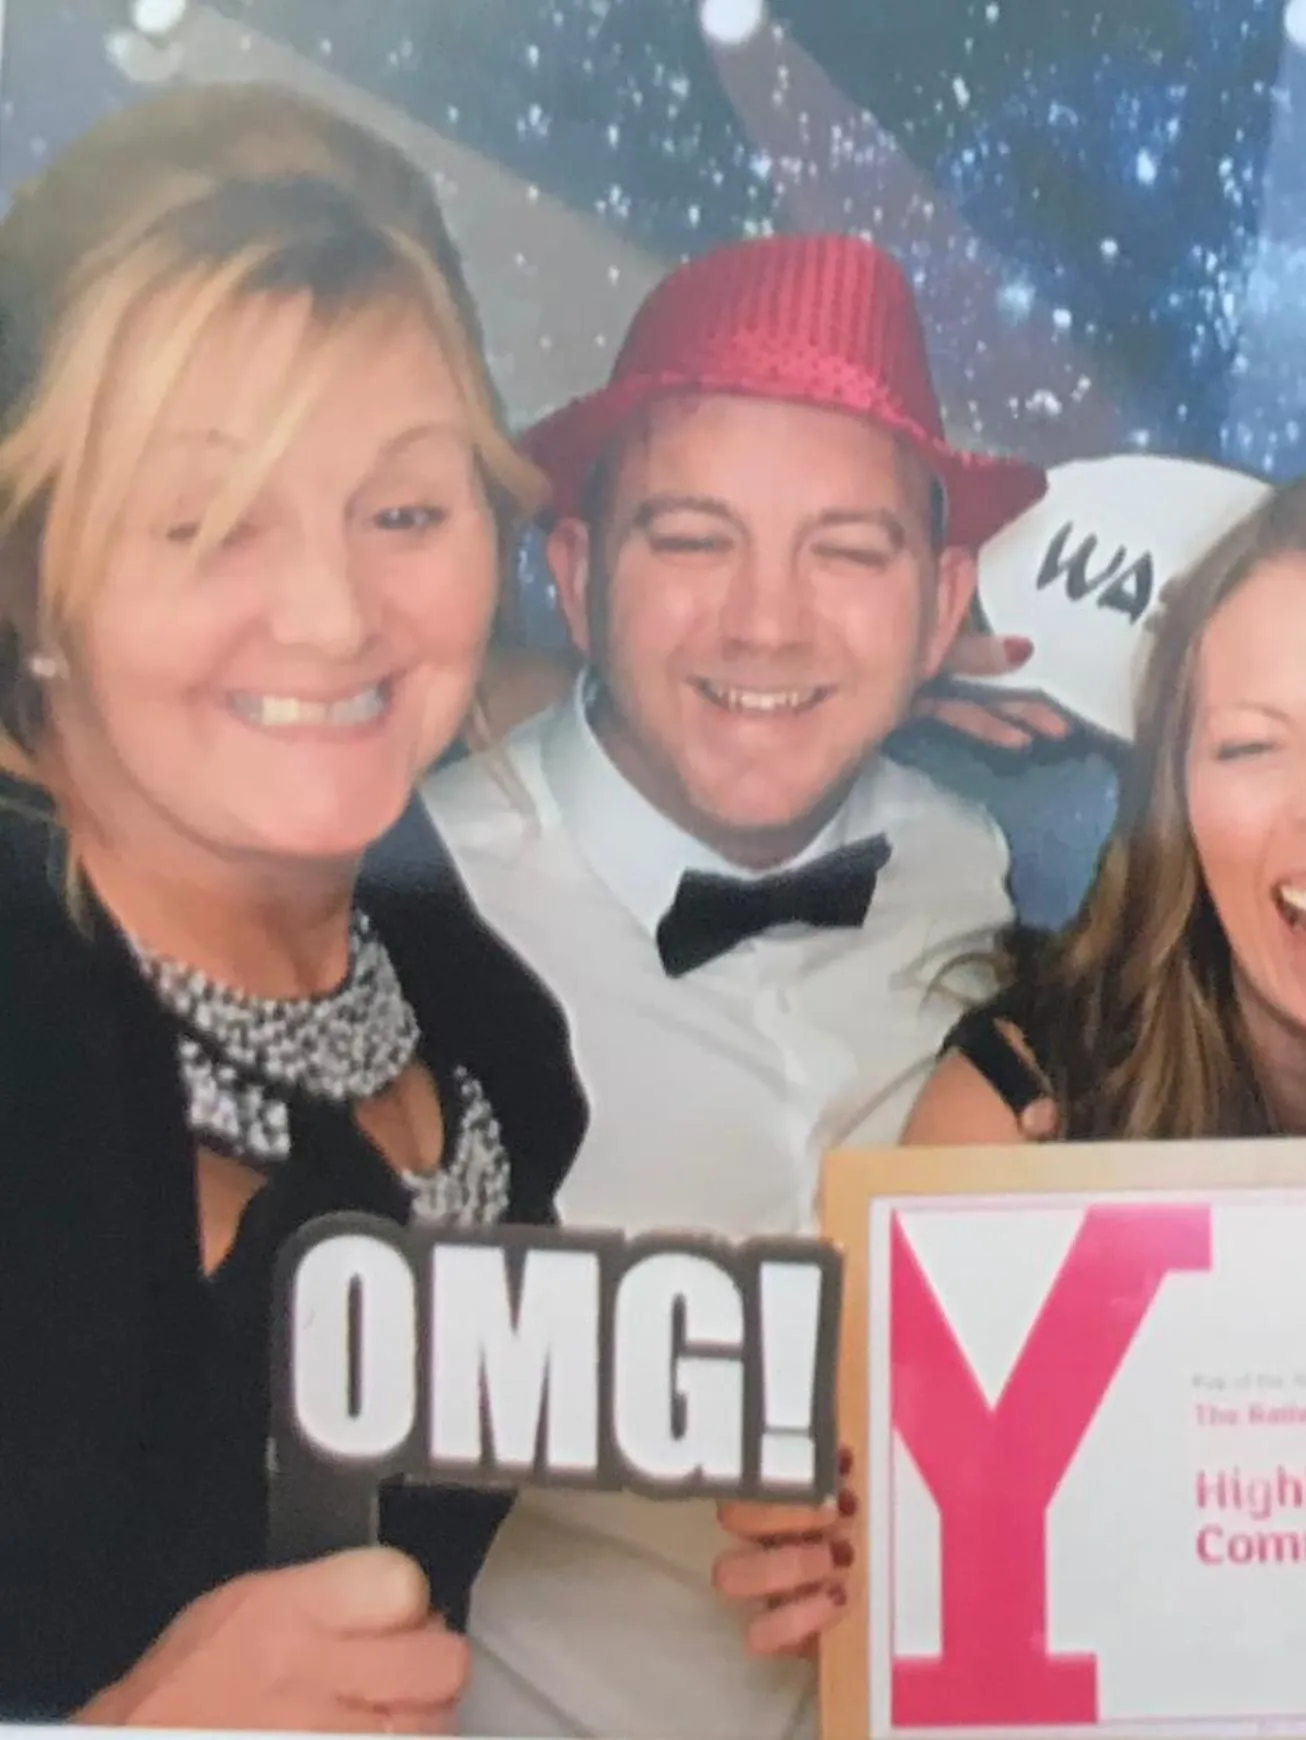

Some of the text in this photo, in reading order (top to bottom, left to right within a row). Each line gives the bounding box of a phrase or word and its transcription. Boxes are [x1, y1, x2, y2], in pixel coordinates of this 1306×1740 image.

[291, 1233, 822, 1487] OMG!
[890, 1203, 1212, 1727] Y
[1195, 1402, 1238, 1426] The
